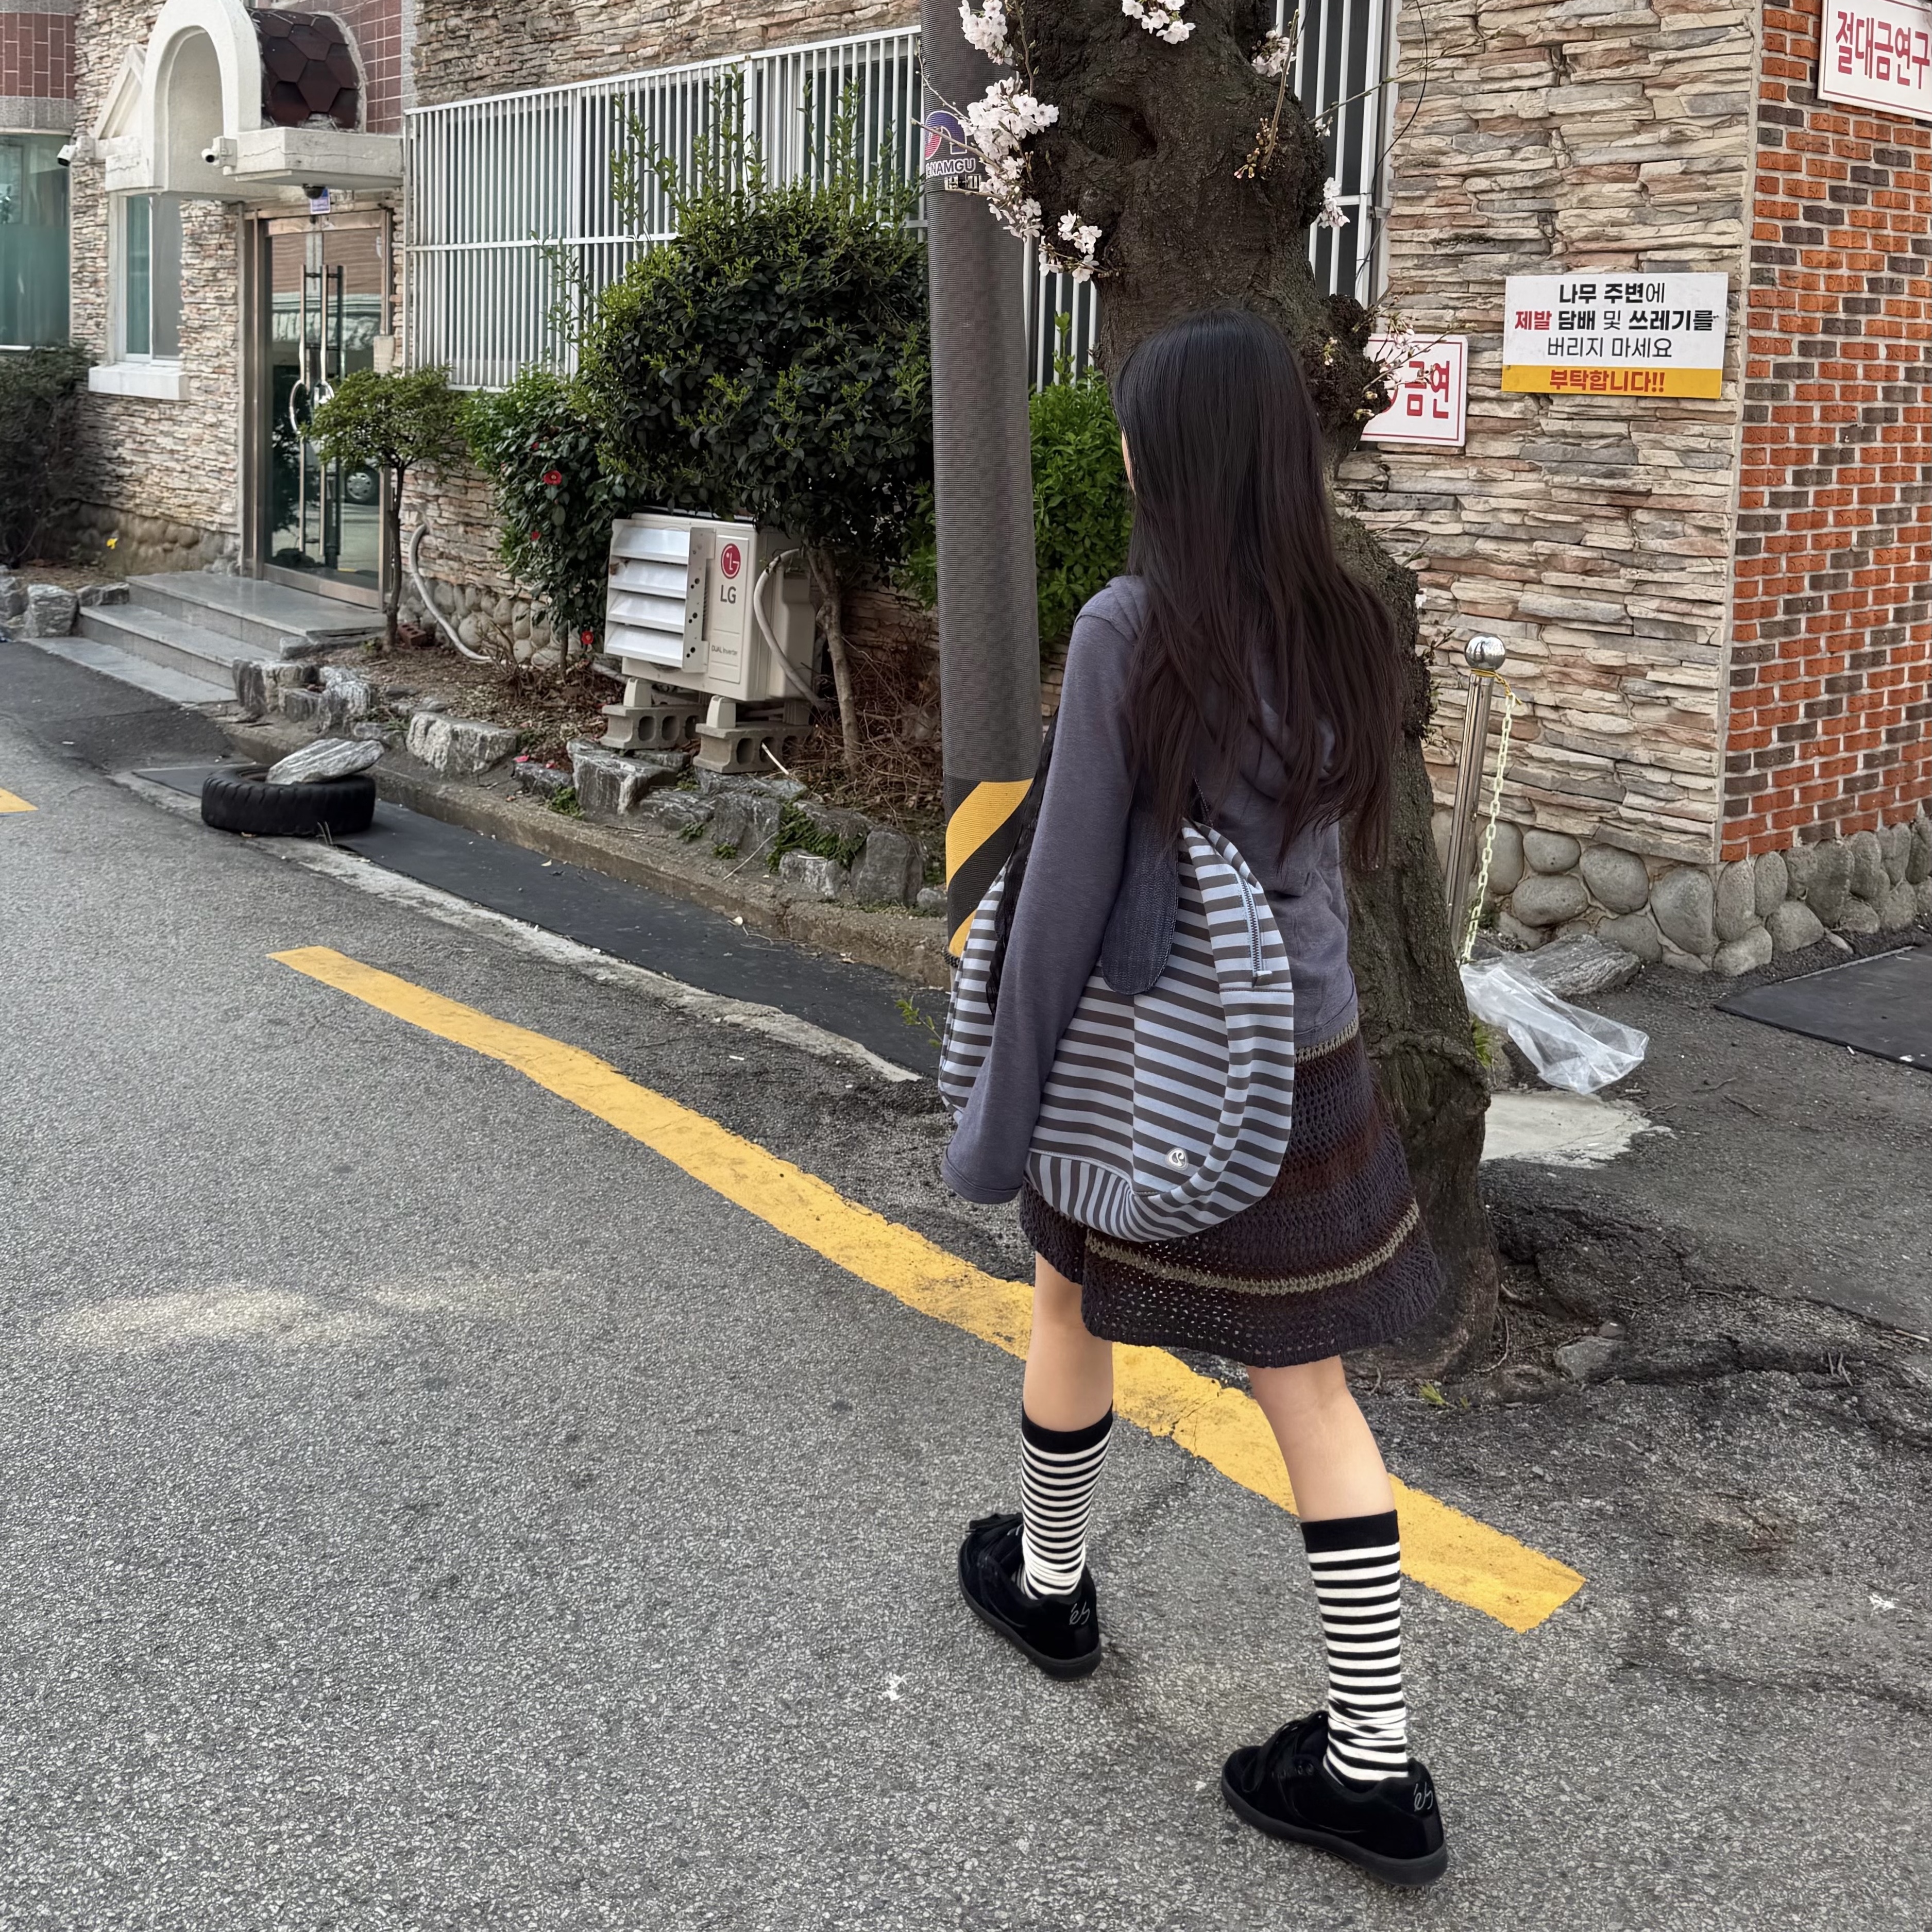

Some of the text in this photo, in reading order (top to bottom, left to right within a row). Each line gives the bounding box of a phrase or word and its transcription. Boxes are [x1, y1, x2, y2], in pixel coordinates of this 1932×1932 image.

[1559, 282, 1665, 304] 나무 주변에
[1515, 310, 1713, 331] 제발 담배 및 쓰레기를
[1548, 337, 1672, 359] 버리지 마세요
[1550, 369, 1665, 393] 부탁합니다!!
[720, 584, 737, 604] LG
